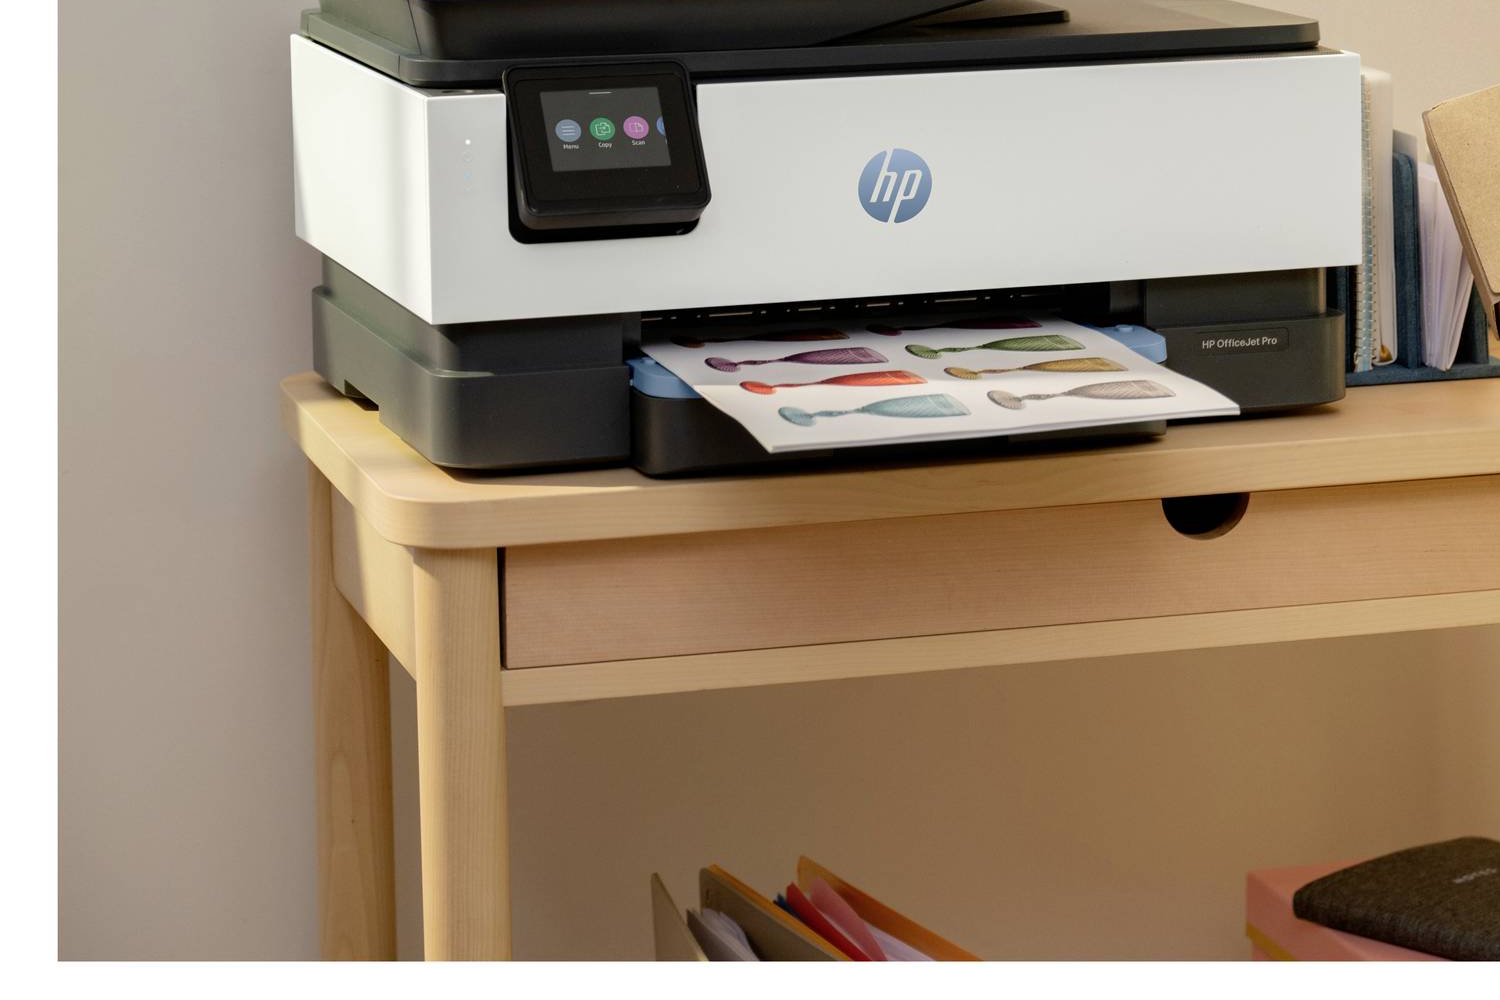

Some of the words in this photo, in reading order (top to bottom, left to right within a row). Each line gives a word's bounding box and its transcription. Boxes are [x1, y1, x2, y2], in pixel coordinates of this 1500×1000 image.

[598, 141, 612, 149] Copy
[866, 148, 925, 223] hp
[1202, 340, 1215, 349] HP
[1216, 337, 1260, 349] OfficeJet
[1261, 336, 1278, 345] Pro
